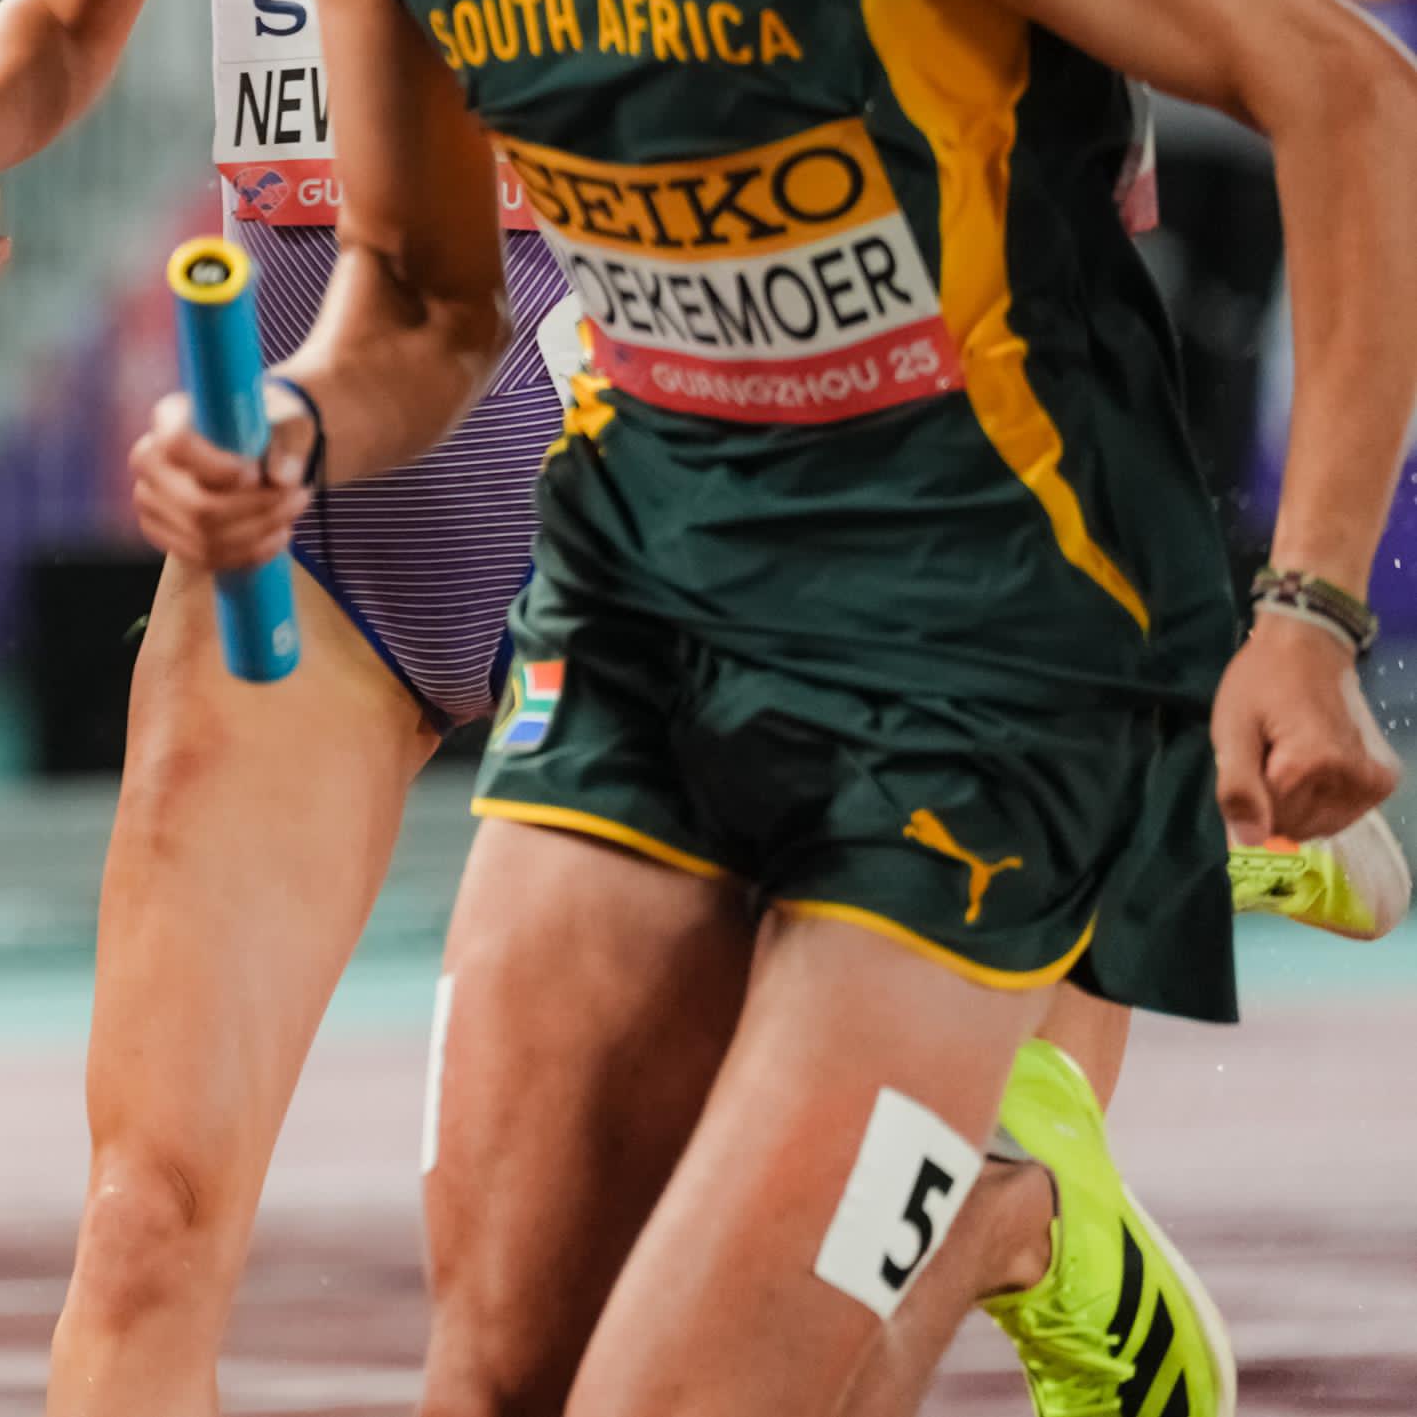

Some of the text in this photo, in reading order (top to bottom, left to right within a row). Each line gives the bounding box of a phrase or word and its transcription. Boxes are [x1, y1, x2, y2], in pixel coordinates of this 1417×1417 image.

[507, 146, 865, 248] SEIKO
[561, 234, 913, 347] OEKEMOER
[651, 340, 941, 408] GUANGZHOU 25
[879, 1157, 955, 1291] 5
